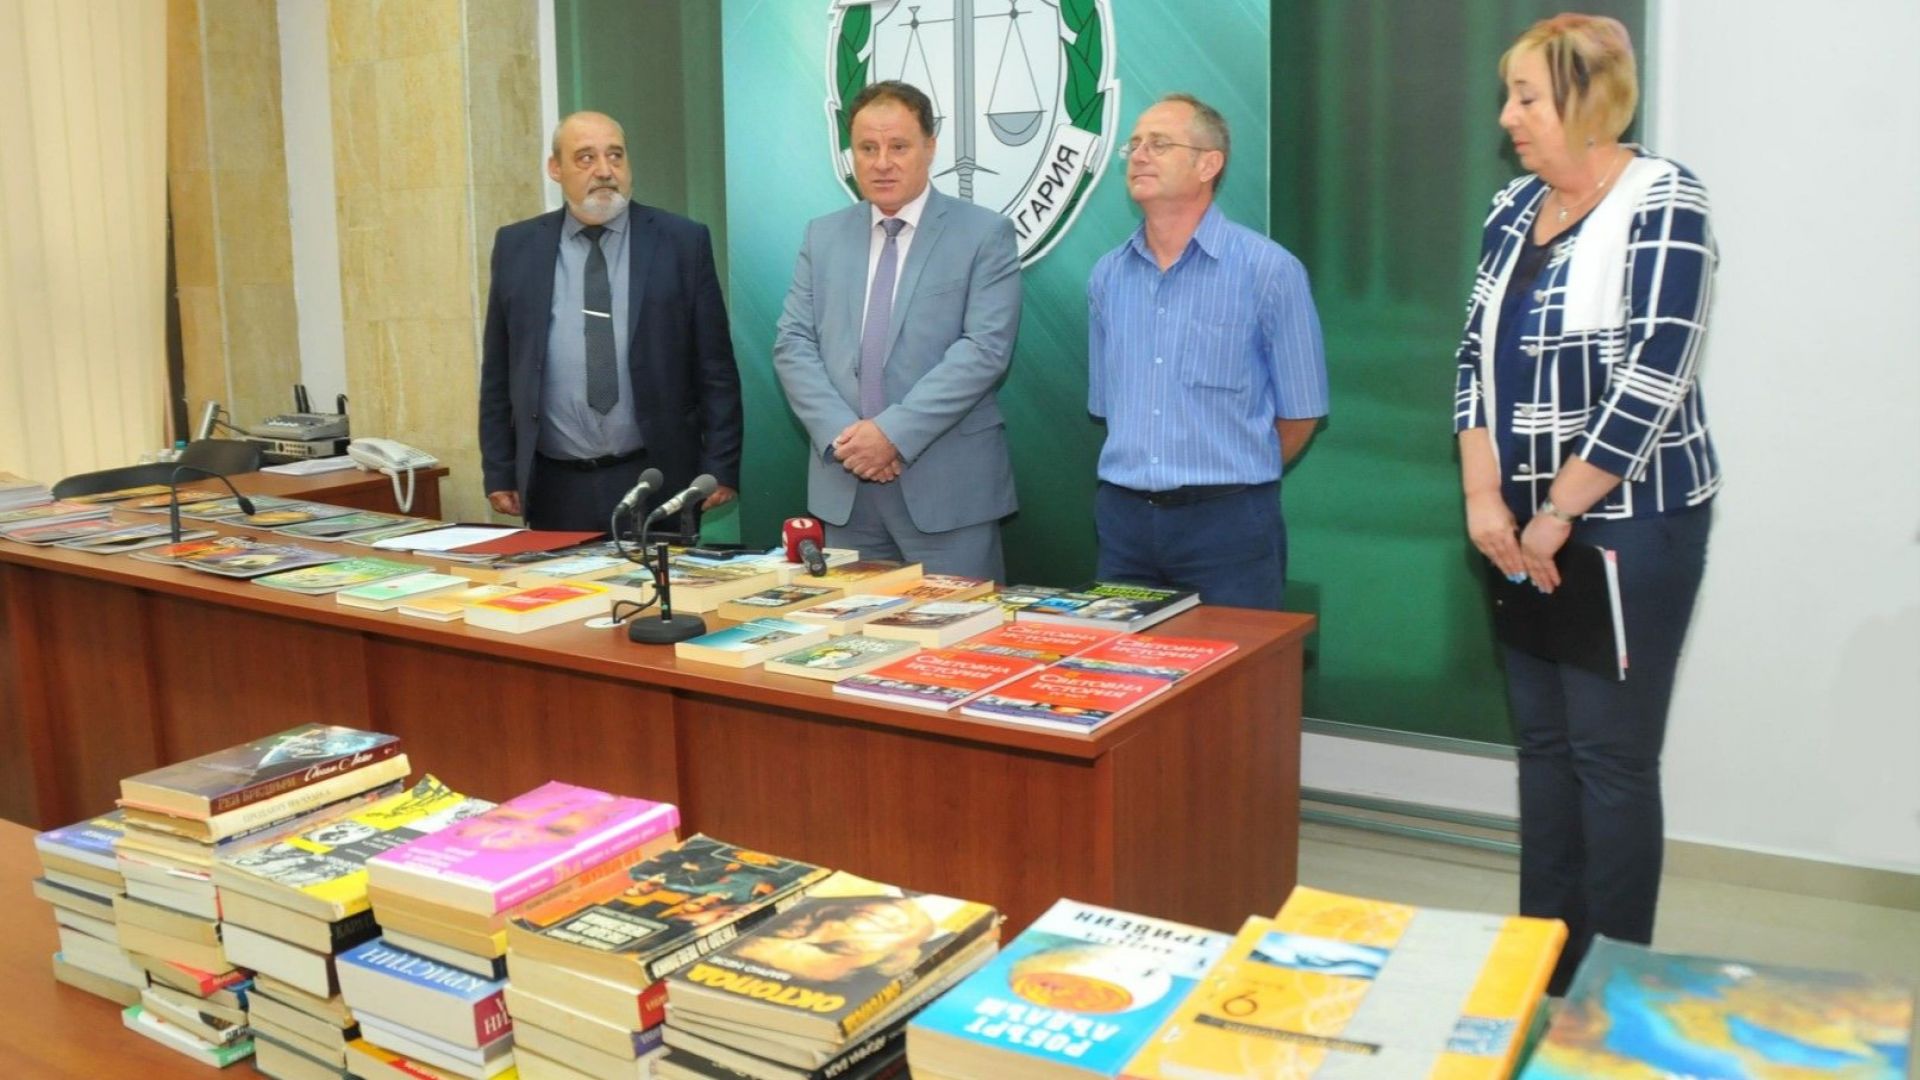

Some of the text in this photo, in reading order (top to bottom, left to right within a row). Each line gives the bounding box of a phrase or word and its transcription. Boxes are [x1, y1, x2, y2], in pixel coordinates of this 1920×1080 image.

[1001, 632, 1081, 645] ИСТОРИЯ
[1006, 625, 1097, 641] СВЕТОВНА
[1110, 646, 1200, 659] ИСТОРИЯ
[1117, 639, 1214, 654] СВЕТОВНА
[904, 662, 993, 679] ИСТОРИЯ
[915, 655, 1011, 674] СВЕТОВНА
[1030, 682, 1127, 698] ИСТОРИЯ
[1039, 674, 1144, 693] СВЕТОВНА
[686, 962, 846, 1013] ОКТОПОД
[963, 1015, 1094, 1058] РОБЪРТ
